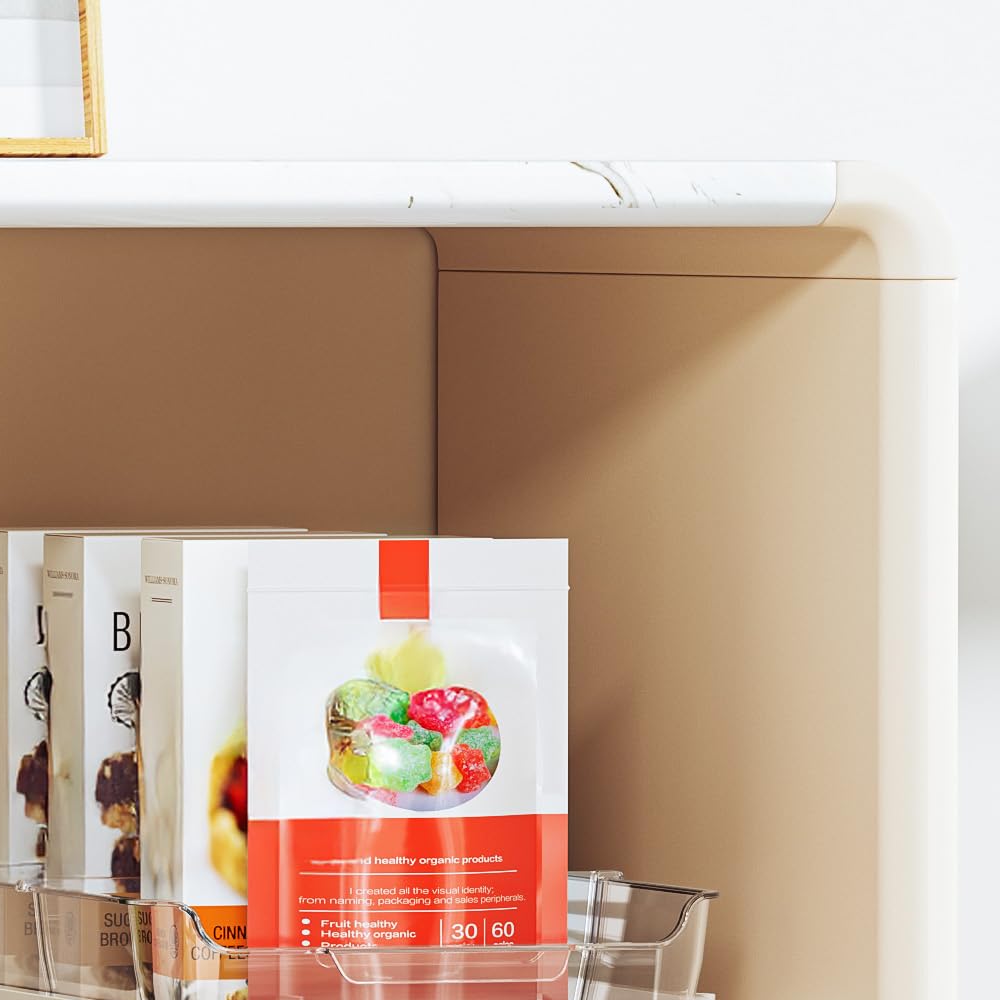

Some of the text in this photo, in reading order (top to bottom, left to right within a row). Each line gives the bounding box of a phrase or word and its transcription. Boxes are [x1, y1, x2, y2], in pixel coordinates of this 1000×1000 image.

[374, 856, 417, 866] healthy
[419, 855, 460, 866] organic
[462, 854, 504, 865] products
[355, 887, 397, 896] created
[398, 887, 411, 895] all
[412, 887, 430, 895] the
[431, 886, 460, 895] visual
[298, 893, 526, 907] from naming, packaging and sales peripherals.
[320, 919, 398, 930] Fruit healthy
[451, 923, 478, 939] 30
[491, 921, 515, 937] 60
[213, 925, 247, 940] CINN
[320, 929, 417, 940] Healthy organic
